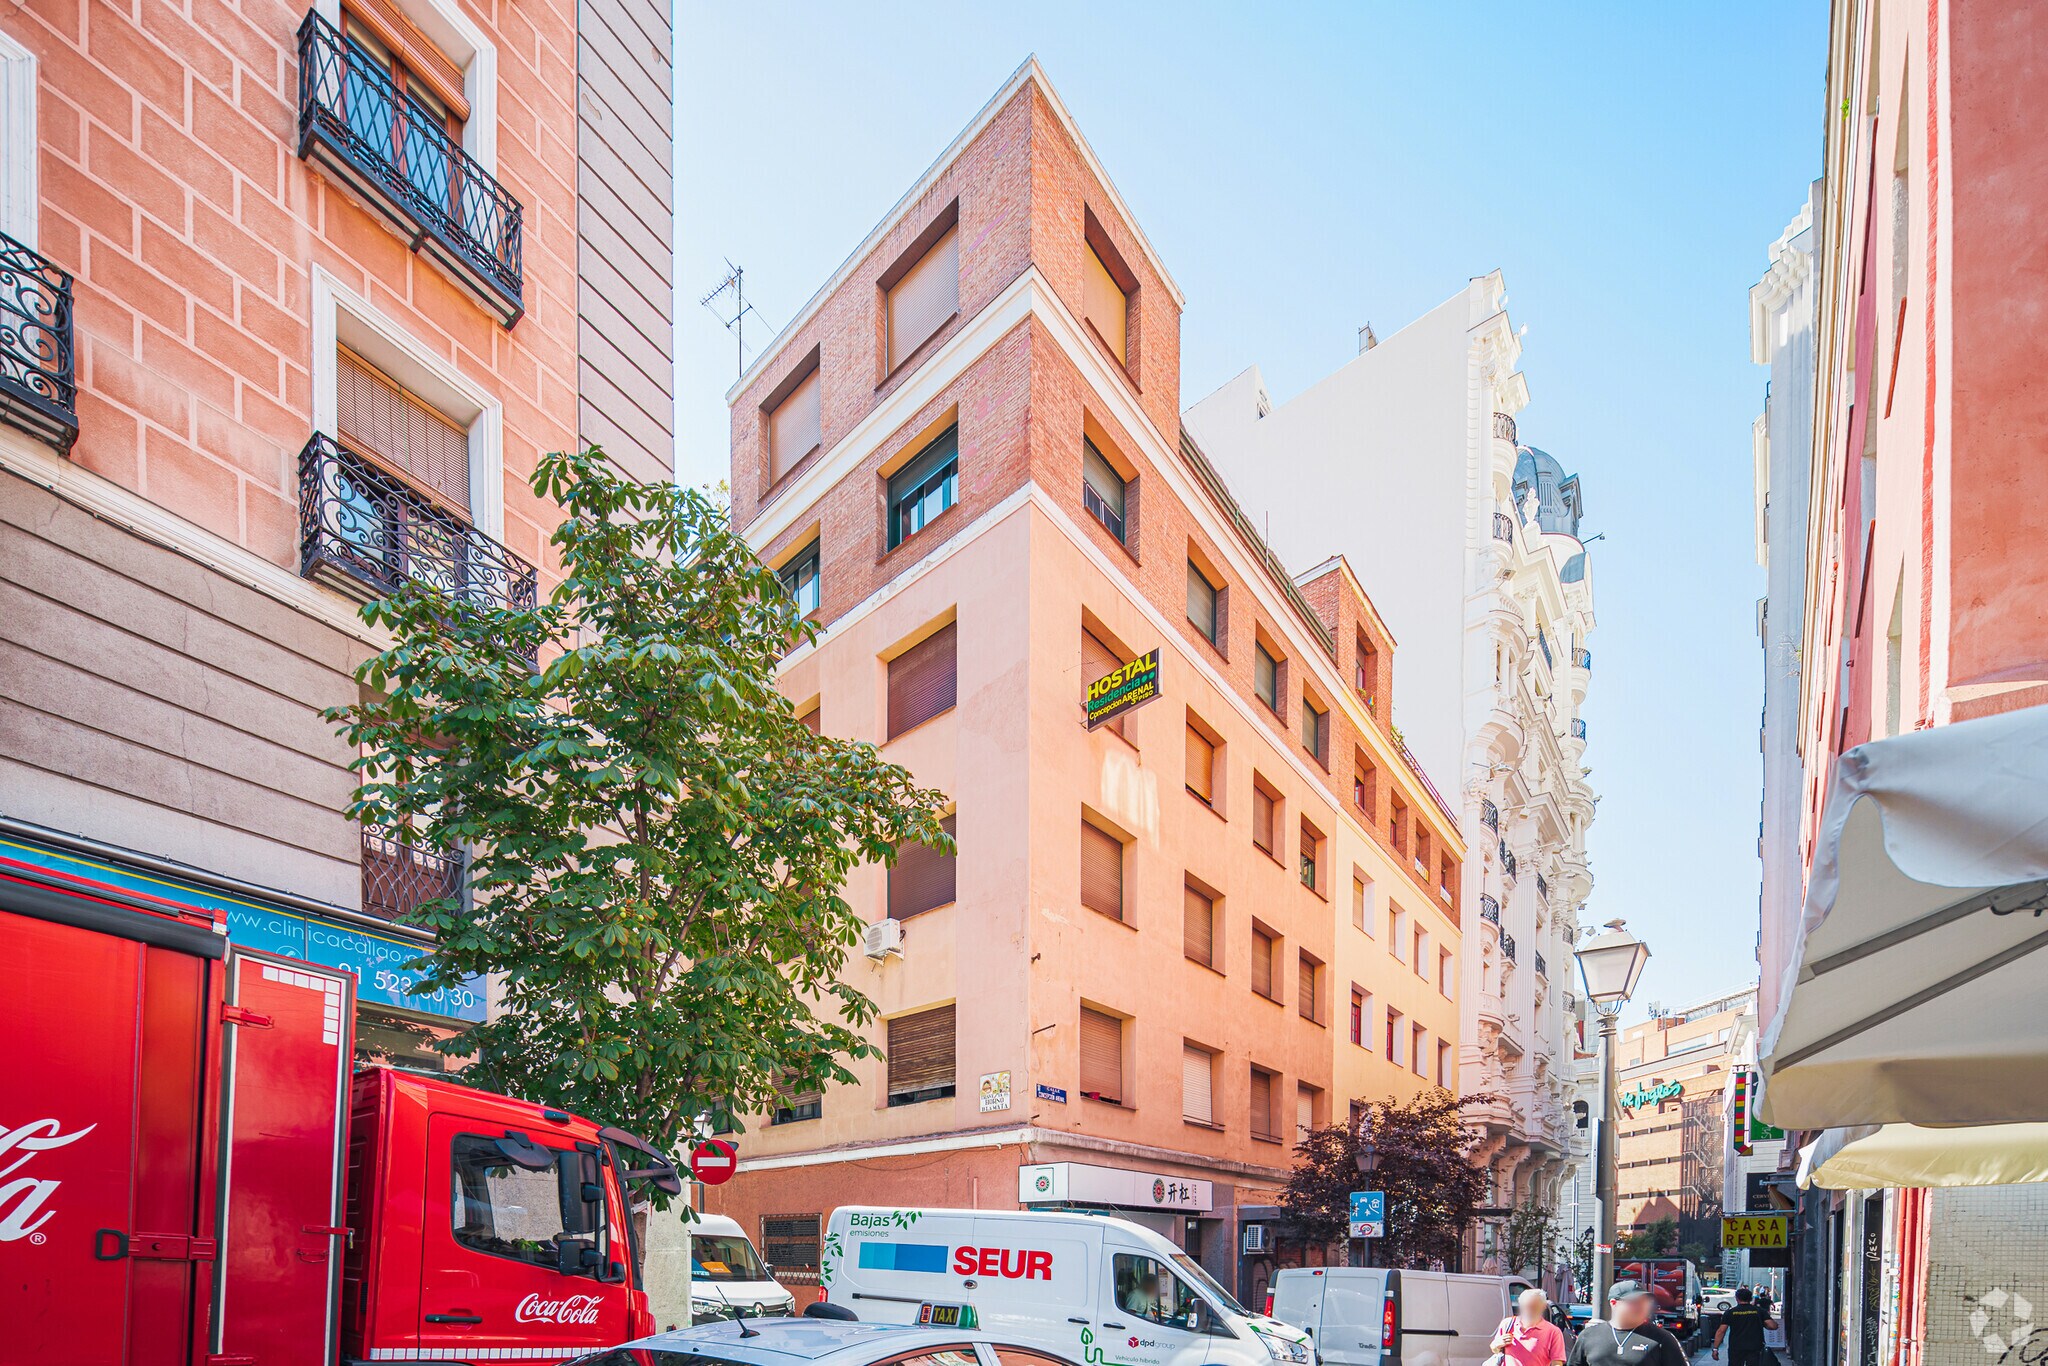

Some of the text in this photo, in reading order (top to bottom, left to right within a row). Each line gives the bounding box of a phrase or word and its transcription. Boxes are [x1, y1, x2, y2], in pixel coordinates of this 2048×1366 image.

[1088, 654, 1157, 702] HOSTAL
[1088, 678, 1141, 712] Residencia
[1121, 682, 1154, 704] ARENAL
[1139, 690, 1154, 702] PISO
[450, 988, 474, 1008] 30
[850, 1213, 891, 1230] Bajas
[1729, 1219, 1779, 1232] CASA
[849, 1229, 890, 1238] emisiones
[1726, 1234, 1782, 1246] REYNA
[952, 1245, 1054, 1281] SEUR
[515, 1293, 605, 1324] Coca-Cola
[934, 1307, 958, 1323] TAXI
